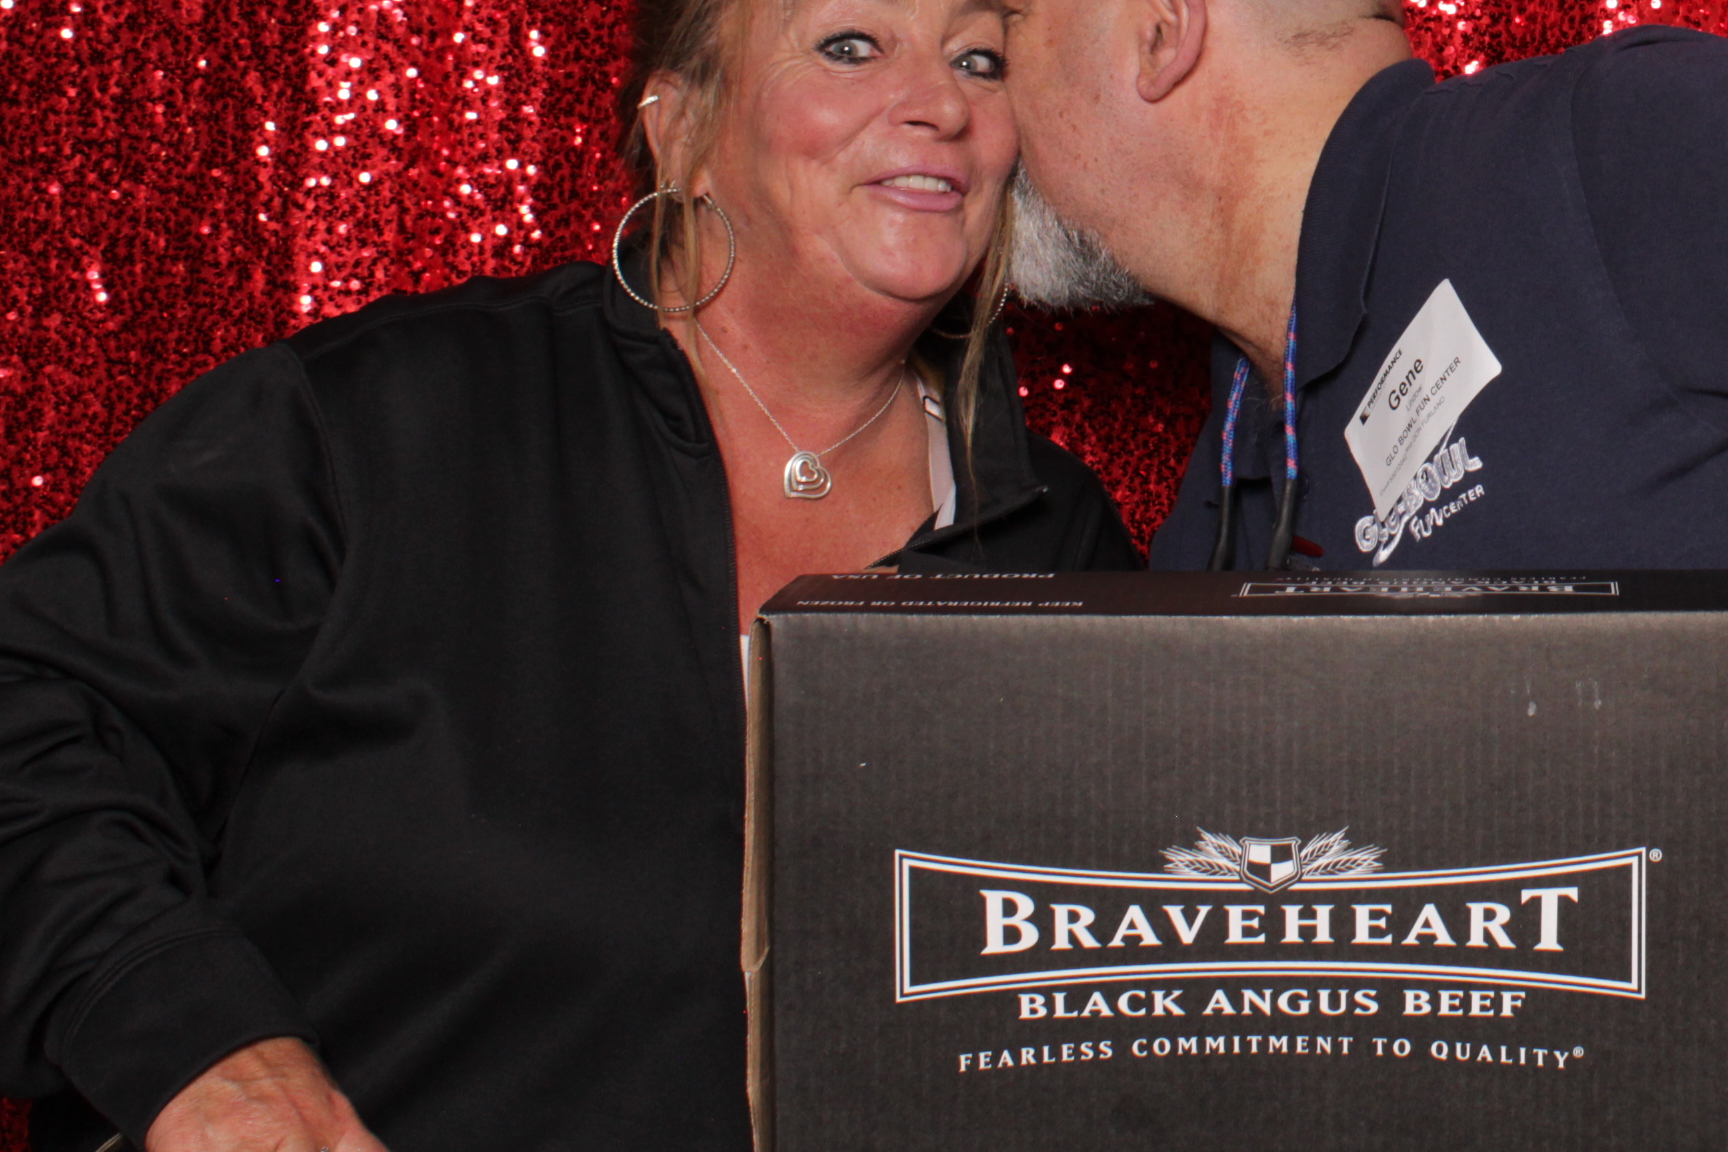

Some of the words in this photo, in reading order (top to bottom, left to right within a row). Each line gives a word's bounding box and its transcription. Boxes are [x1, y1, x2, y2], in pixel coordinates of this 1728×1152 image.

[1367, 348, 1402, 408] PERFORMANCE
[1388, 359, 1423, 410] Gene
[1386, 444, 1399, 466] GLO
[1398, 417, 1417, 445] BOWL
[1415, 394, 1431, 416] FUN
[1430, 356, 1461, 395] CENTER
[979, 886, 1579, 955] BRAVEHEART
[1017, 989, 1187, 1020] BLACK
[1201, 989, 1380, 1017] ANGUS
[1402, 989, 1527, 1018] BEEF
[958, 1039, 1114, 1073] FEARLESS
[1131, 1035, 1354, 1058] COMMITMENT
[1372, 1037, 1412, 1058] TO
